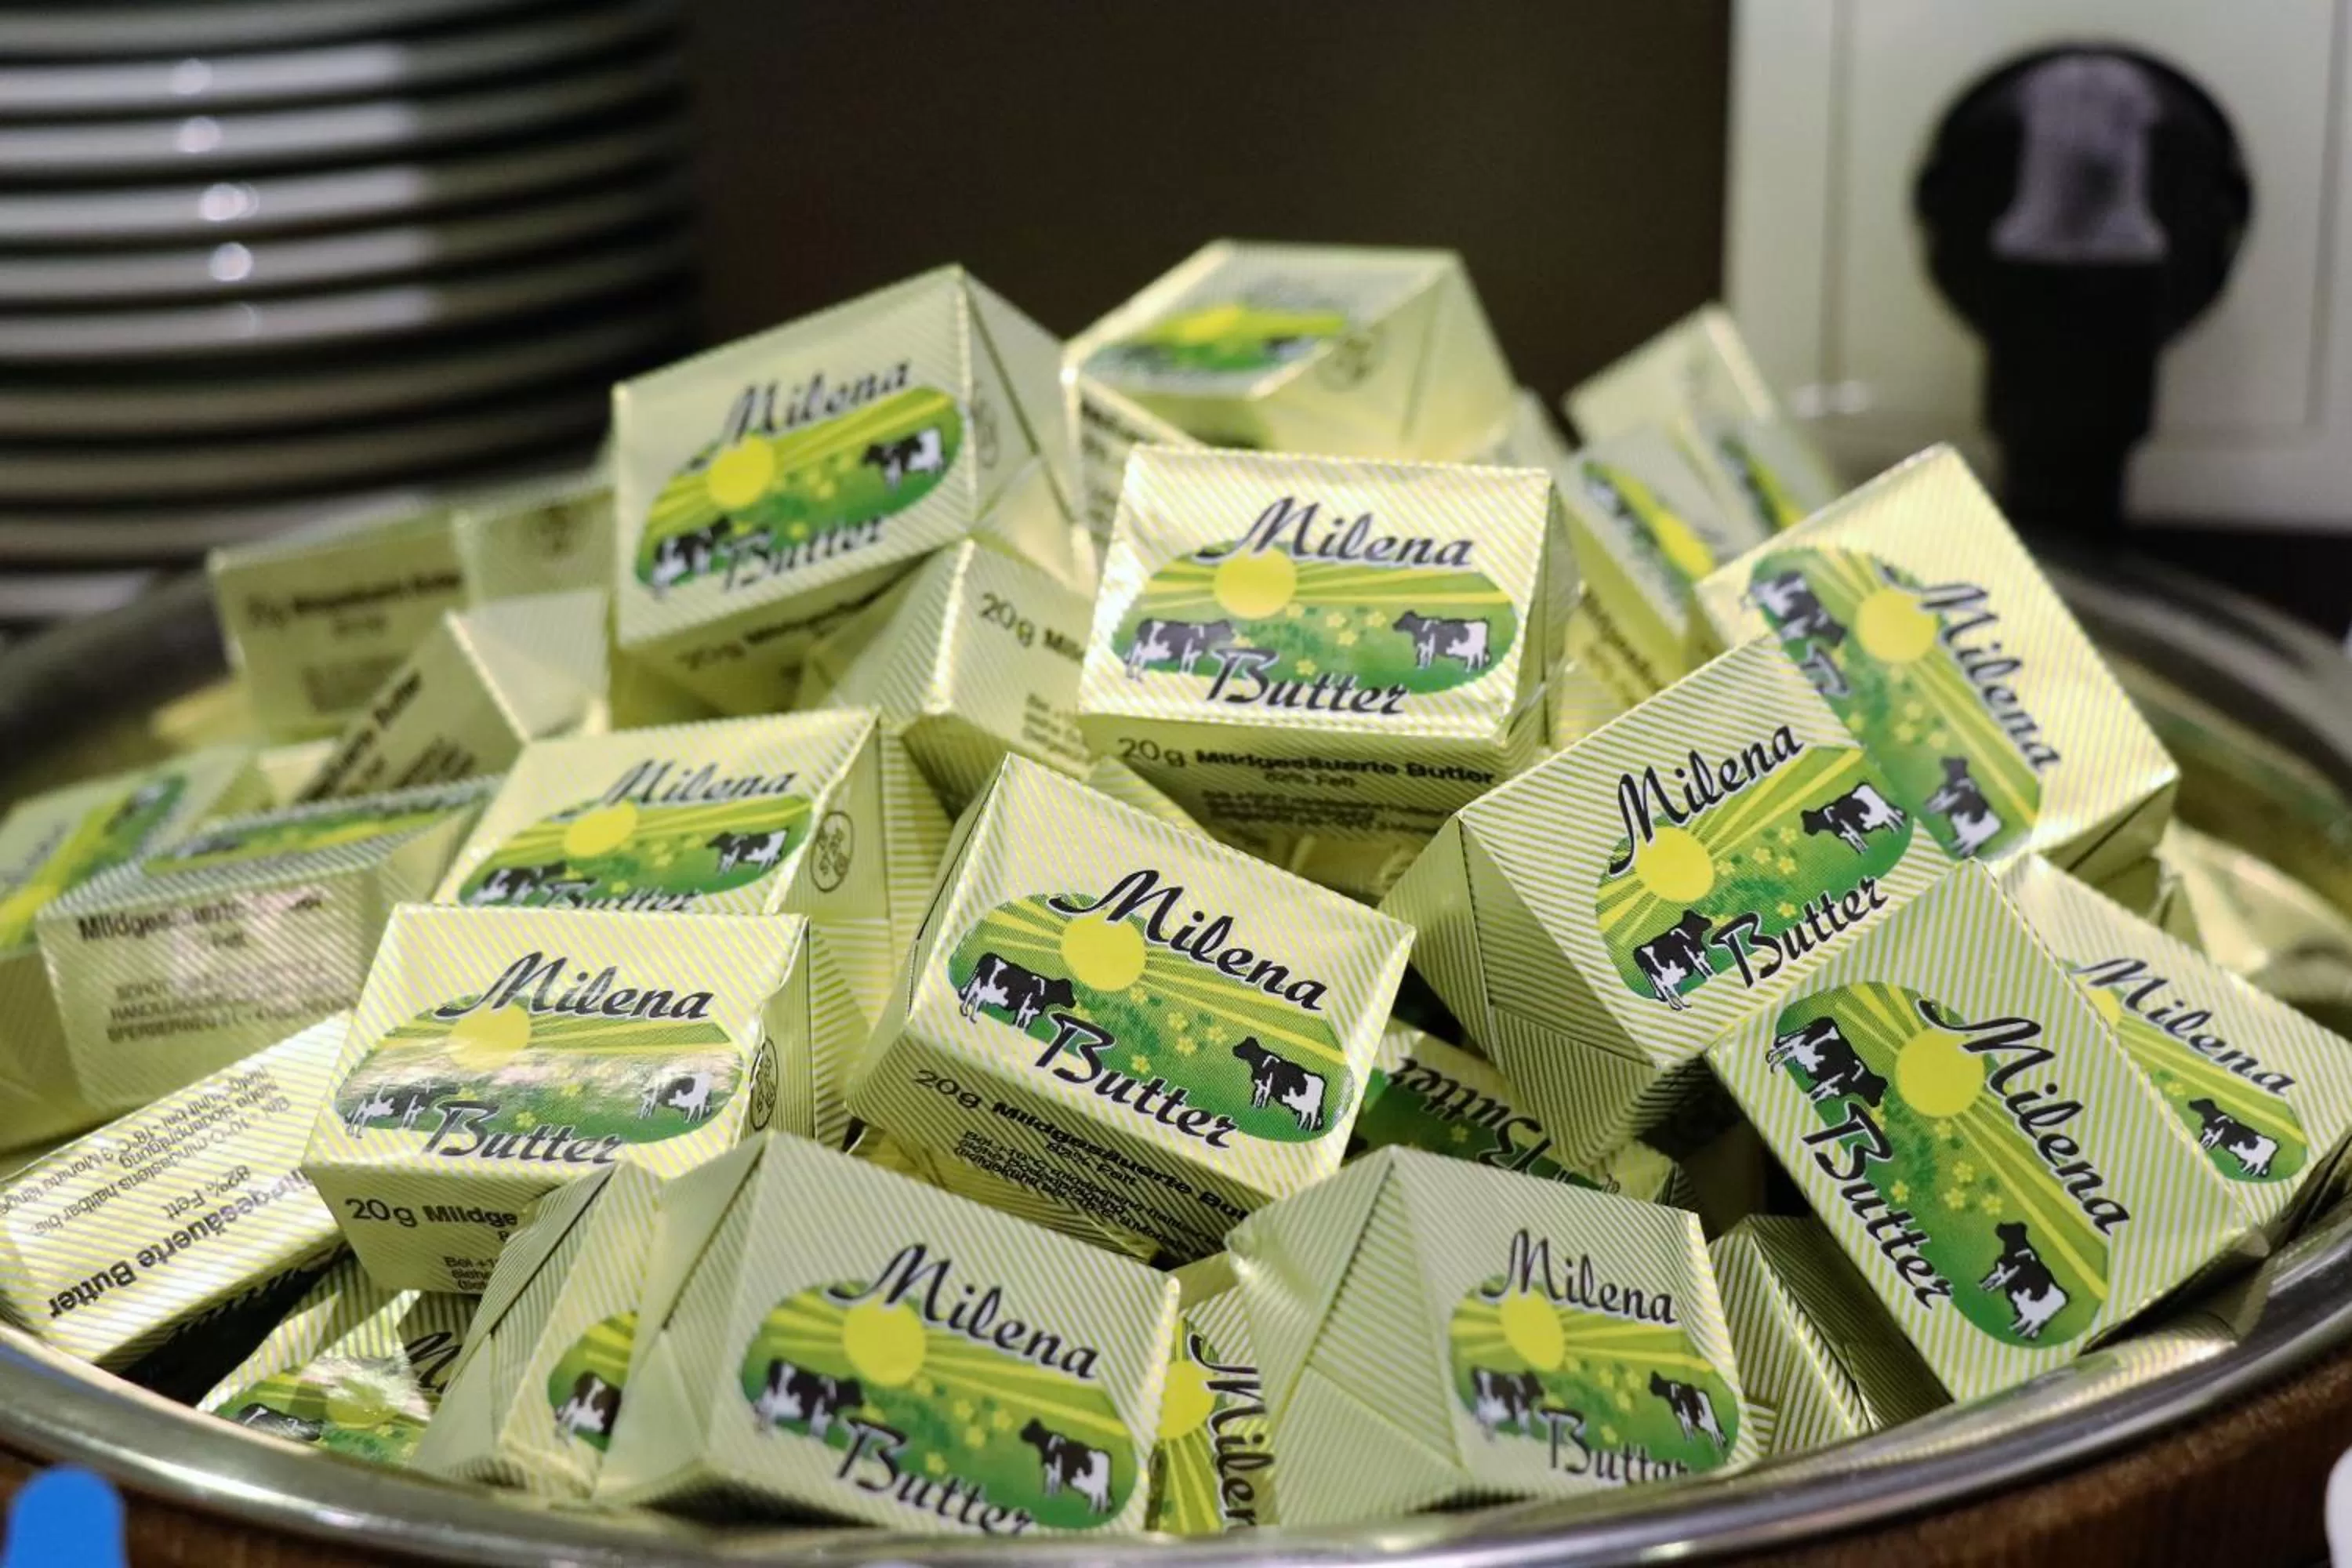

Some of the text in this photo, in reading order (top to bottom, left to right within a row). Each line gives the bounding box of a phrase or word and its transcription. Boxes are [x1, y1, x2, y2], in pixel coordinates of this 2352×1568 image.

[1196, 496, 1472, 566] Milena
[1207, 648, 1408, 714] Butter
[1882, 564, 2060, 764] Milena
[557, 759, 798, 818] Milena
[1118, 738, 1185, 767] 20g
[1406, 760, 1495, 784] Butter
[1607, 725, 1802, 876] Milena
[435, 951, 714, 1018] Milena
[1048, 869, 1327, 1011] Milena
[1715, 875, 1888, 986] Butter
[1036, 1011, 1238, 1149] Butter
[2067, 958, 2296, 1096] Milena
[424, 1101, 624, 1164] Butter
[916, 1069, 1250, 1221] 20g Mildgesäuerte But
[1388, 1057, 1552, 1175] Butter
[1918, 998, 2130, 1236] Milena
[161, 1165, 251, 1220] 82% Fett
[345, 1198, 518, 1228] 20g Mildge
[1803, 1102, 1953, 1309] Butter
[48, 1260, 137, 1318] Butter
[828, 1243, 1099, 1379] Milena
[1481, 1229, 1676, 1323] Milena
[836, 1415, 1033, 1534] Butter
